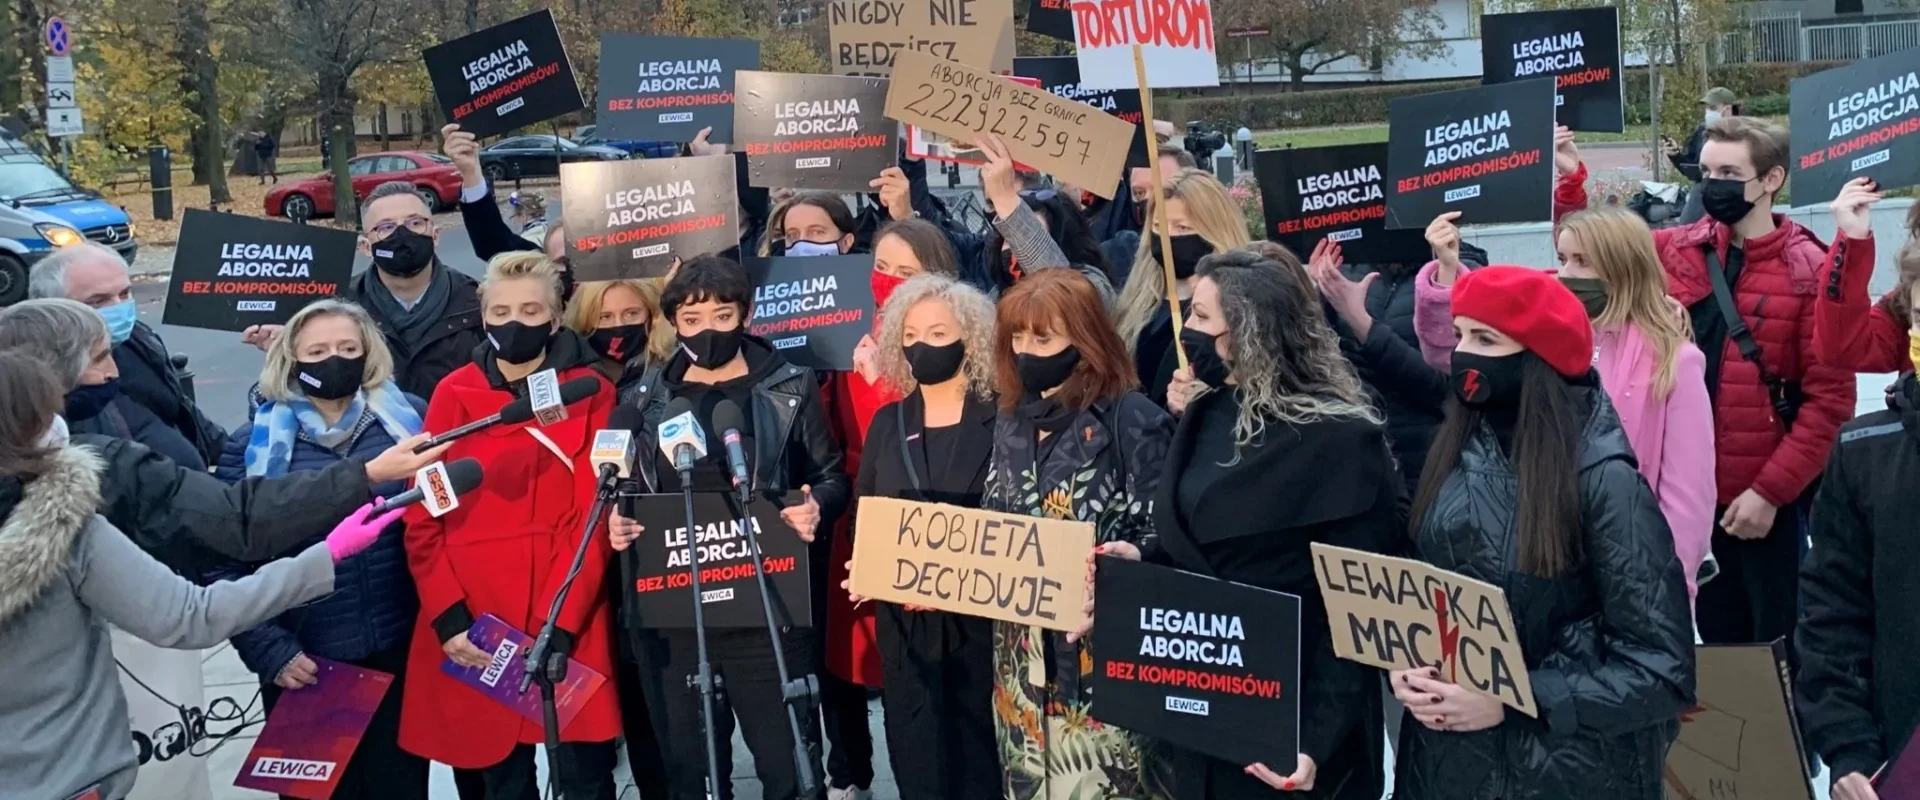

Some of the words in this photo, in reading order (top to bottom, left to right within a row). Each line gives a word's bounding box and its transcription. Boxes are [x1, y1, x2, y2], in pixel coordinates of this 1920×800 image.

[832, 0, 905, 26] NIGDY
[929, 0, 977, 26] NIE
[1071, 0, 1214, 53] TORTUROM
[1513, 30, 1584, 59] LEGALNA
[461, 39, 529, 80] LEGALNA
[638, 58, 722, 77] LEGALNA
[1515, 50, 1585, 77] ABORCJA
[469, 55, 534, 95] ABORCJA
[637, 75, 721, 93] ABORCJA
[930, 63, 1003, 101] ABORCJA
[1009, 89, 1040, 111] BEZ
[1556, 67, 1611, 88] OMISÓW!
[453, 101, 474, 119] BEZ
[473, 61, 560, 110] KOMPROMISÓW!
[608, 98, 634, 111] BEZ
[636, 90, 736, 109] KOMPROMISÓ
[1829, 71, 1920, 121] LEGALNA
[498, 98, 523, 115] LEWICA
[660, 113, 691, 122] LEWICA
[774, 98, 860, 119] LEGALNA
[1828, 94, 1920, 141] ABORCJA
[774, 116, 859, 136] ABORCJA
[903, 83, 1092, 166] 222922597
[1425, 110, 1512, 147] LEGALNA
[745, 143, 769, 156] BEZ
[773, 134, 887, 153] KOMPROMISÓW!
[1424, 132, 1510, 168] ABORCJA
[1800, 149, 1825, 170] BEZ
[1828, 117, 1920, 160] KOMPROMIS
[797, 159, 829, 167] LEWICA
[1397, 176, 1421, 193] BEZ
[1423, 149, 1541, 188] KOMPROMISÓW!
[1853, 151, 1888, 169] LEWICA
[1297, 164, 1382, 195] LEGALNA
[605, 180, 696, 209] LEGALNA
[1301, 184, 1384, 213] ABORCJA
[1446, 187, 1478, 200] LEWICA
[607, 199, 696, 228] ABORCJA
[1278, 219, 1301, 234] BEZ
[1303, 205, 1386, 230] KOMPROMIS
[577, 235, 603, 251] BEZ
[1329, 229, 1360, 241] LEWICA
[220, 243, 314, 261] LEGALNA
[635, 245, 667, 257] LEWICA
[217, 261, 310, 278] ABORCJA
[182, 281, 210, 294] BEZ
[214, 281, 338, 295] KOMPROMISÓW!
[754, 275, 838, 302] LEGALNA
[239, 301, 274, 310] LEWICA
[752, 293, 836, 319] ABORCJA
[750, 308, 863, 336] KOMPROMISÓW!
[897, 506, 1045, 567] KOBIETA
[636, 575, 664, 593] BEZ
[701, 590, 732, 601] EWICA
[892, 558, 1062, 621] DECYDUJE
[1318, 554, 1510, 644] LEWACKA
[1139, 606, 1245, 640] LEGALNA
[483, 642, 515, 684] LEWICA
[1139, 635, 1244, 667] ABORCJA
[1106, 660, 1135, 681] BEZ
[1138, 663, 1282, 700] KOMPROMISÓW!
[1168, 698, 1207, 714] LEWICA
[257, 759, 329, 778] LEWICA
